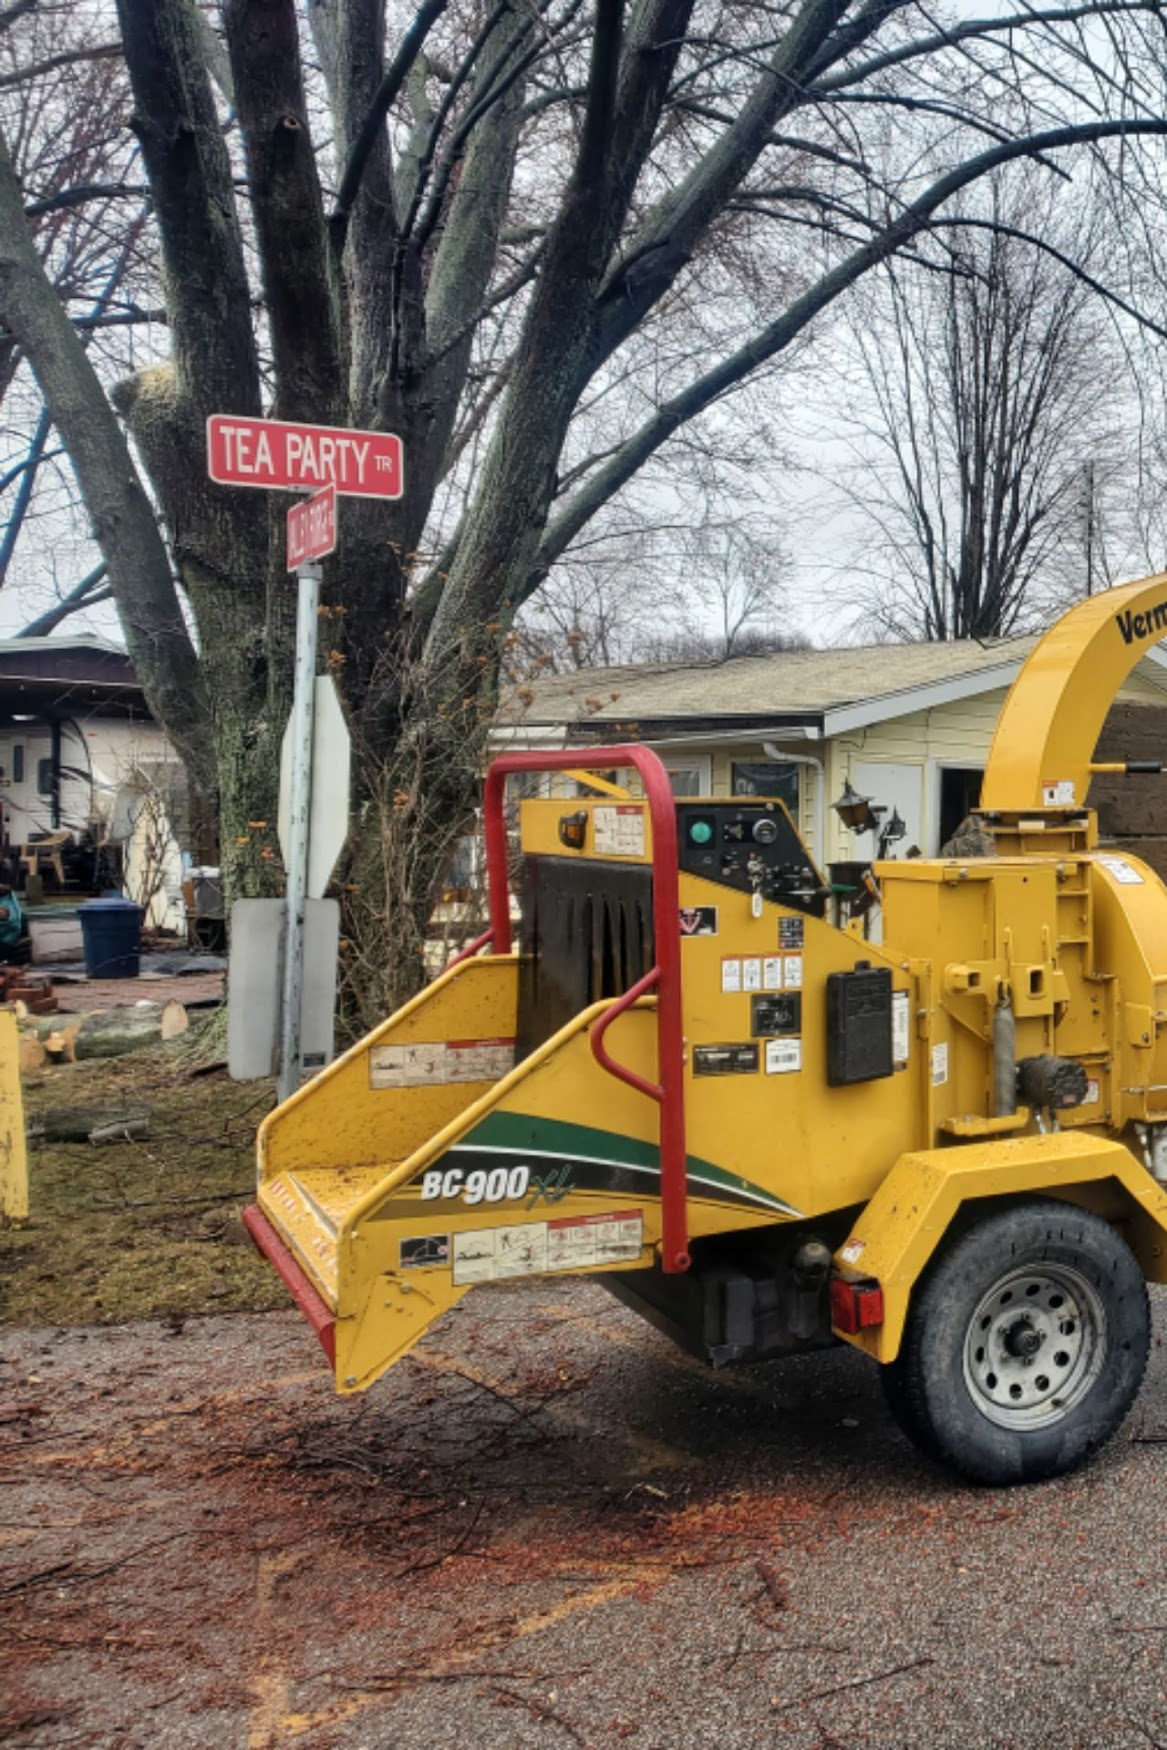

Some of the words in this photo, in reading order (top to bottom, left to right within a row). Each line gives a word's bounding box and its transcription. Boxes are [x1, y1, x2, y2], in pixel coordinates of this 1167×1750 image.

[219, 425, 275, 476] TEA
[285, 432, 370, 484] PARTY
[374, 455, 392, 473] TR
